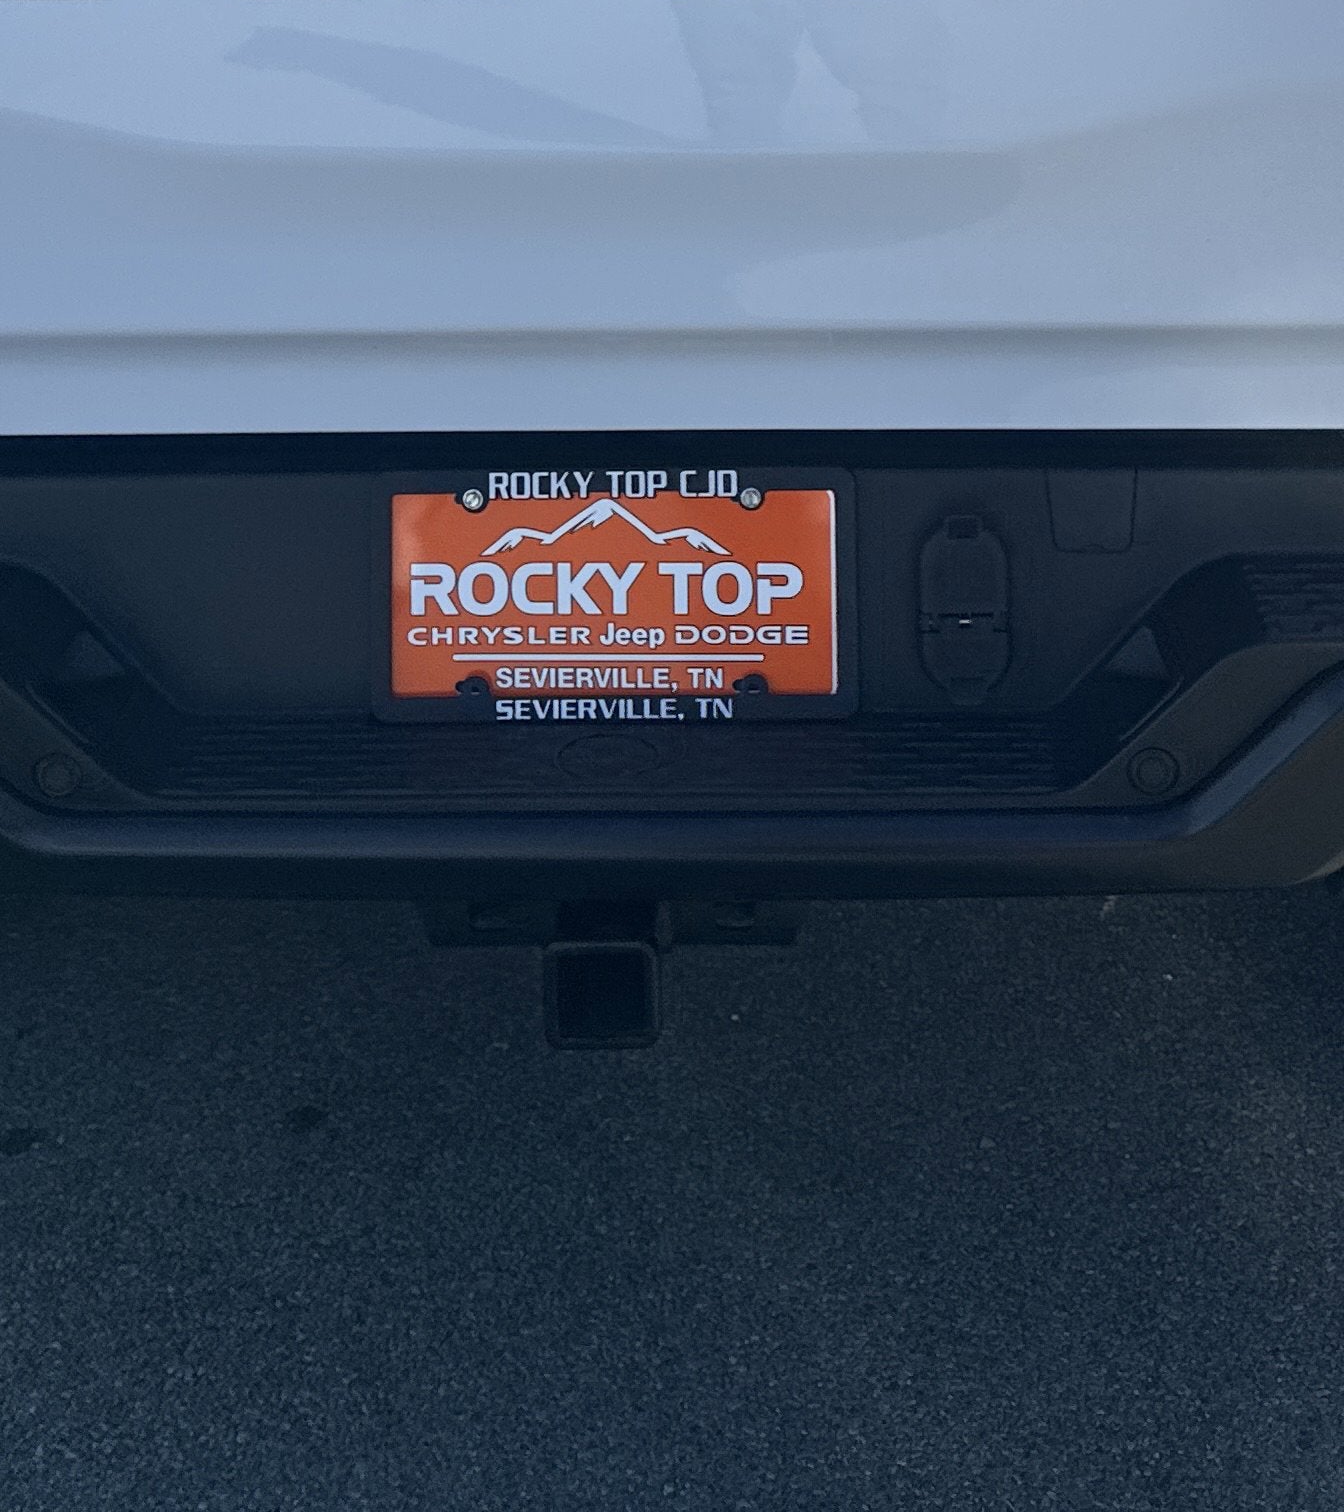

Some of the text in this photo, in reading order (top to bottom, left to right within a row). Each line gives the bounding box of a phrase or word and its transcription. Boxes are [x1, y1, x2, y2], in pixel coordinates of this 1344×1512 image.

[488, 469, 739, 499] ROCKY TOP CJD
[409, 562, 805, 616] ROCKY TOP
[406, 623, 810, 649] CHRYSLER Jeep DODGE
[495, 667, 725, 692] SEVIERVILLE, TN
[495, 697, 734, 721] SEVIERVILLE, TN
